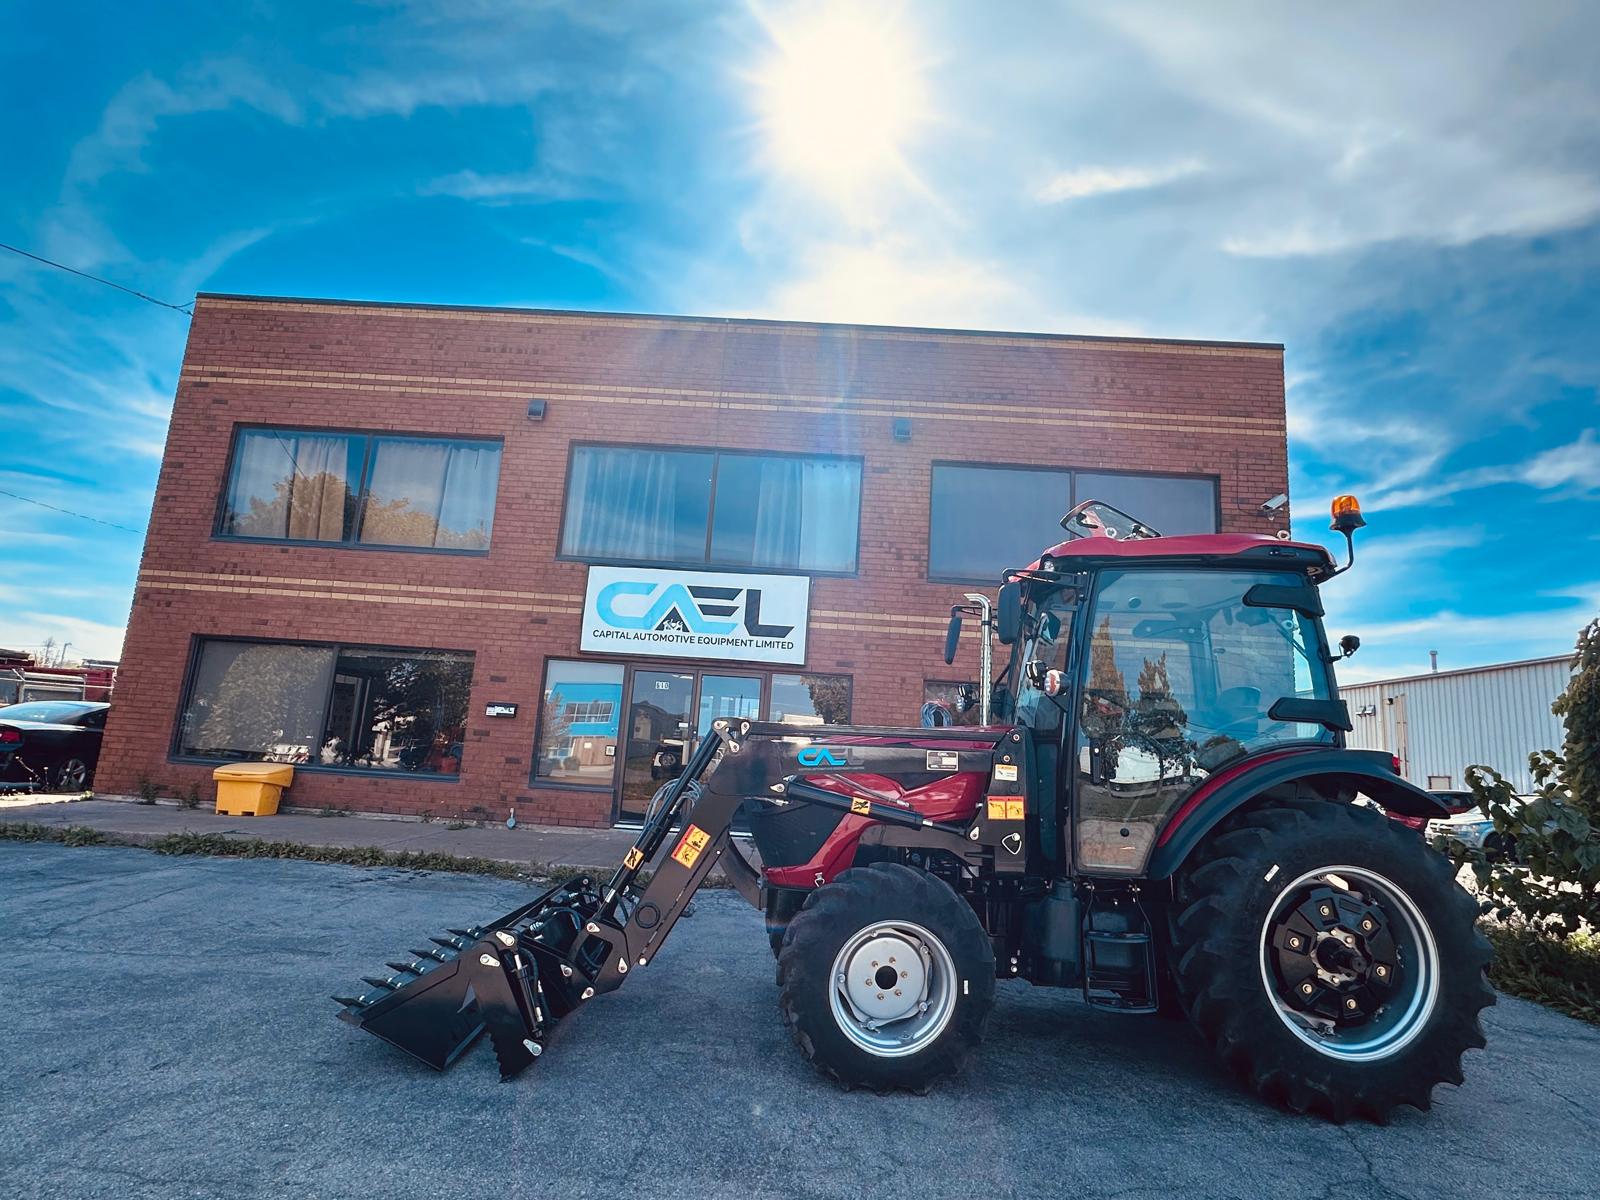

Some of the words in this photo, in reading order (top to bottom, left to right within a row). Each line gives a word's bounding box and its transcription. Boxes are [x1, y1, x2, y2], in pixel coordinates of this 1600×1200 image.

[596, 581, 795, 638] CAEL
[592, 629, 631, 640] CAPITAL
[633, 632, 696, 644] AUTOMOTIVE
[697, 636, 754, 648] EQUIPMENT
[755, 640, 794, 650] LIMITED
